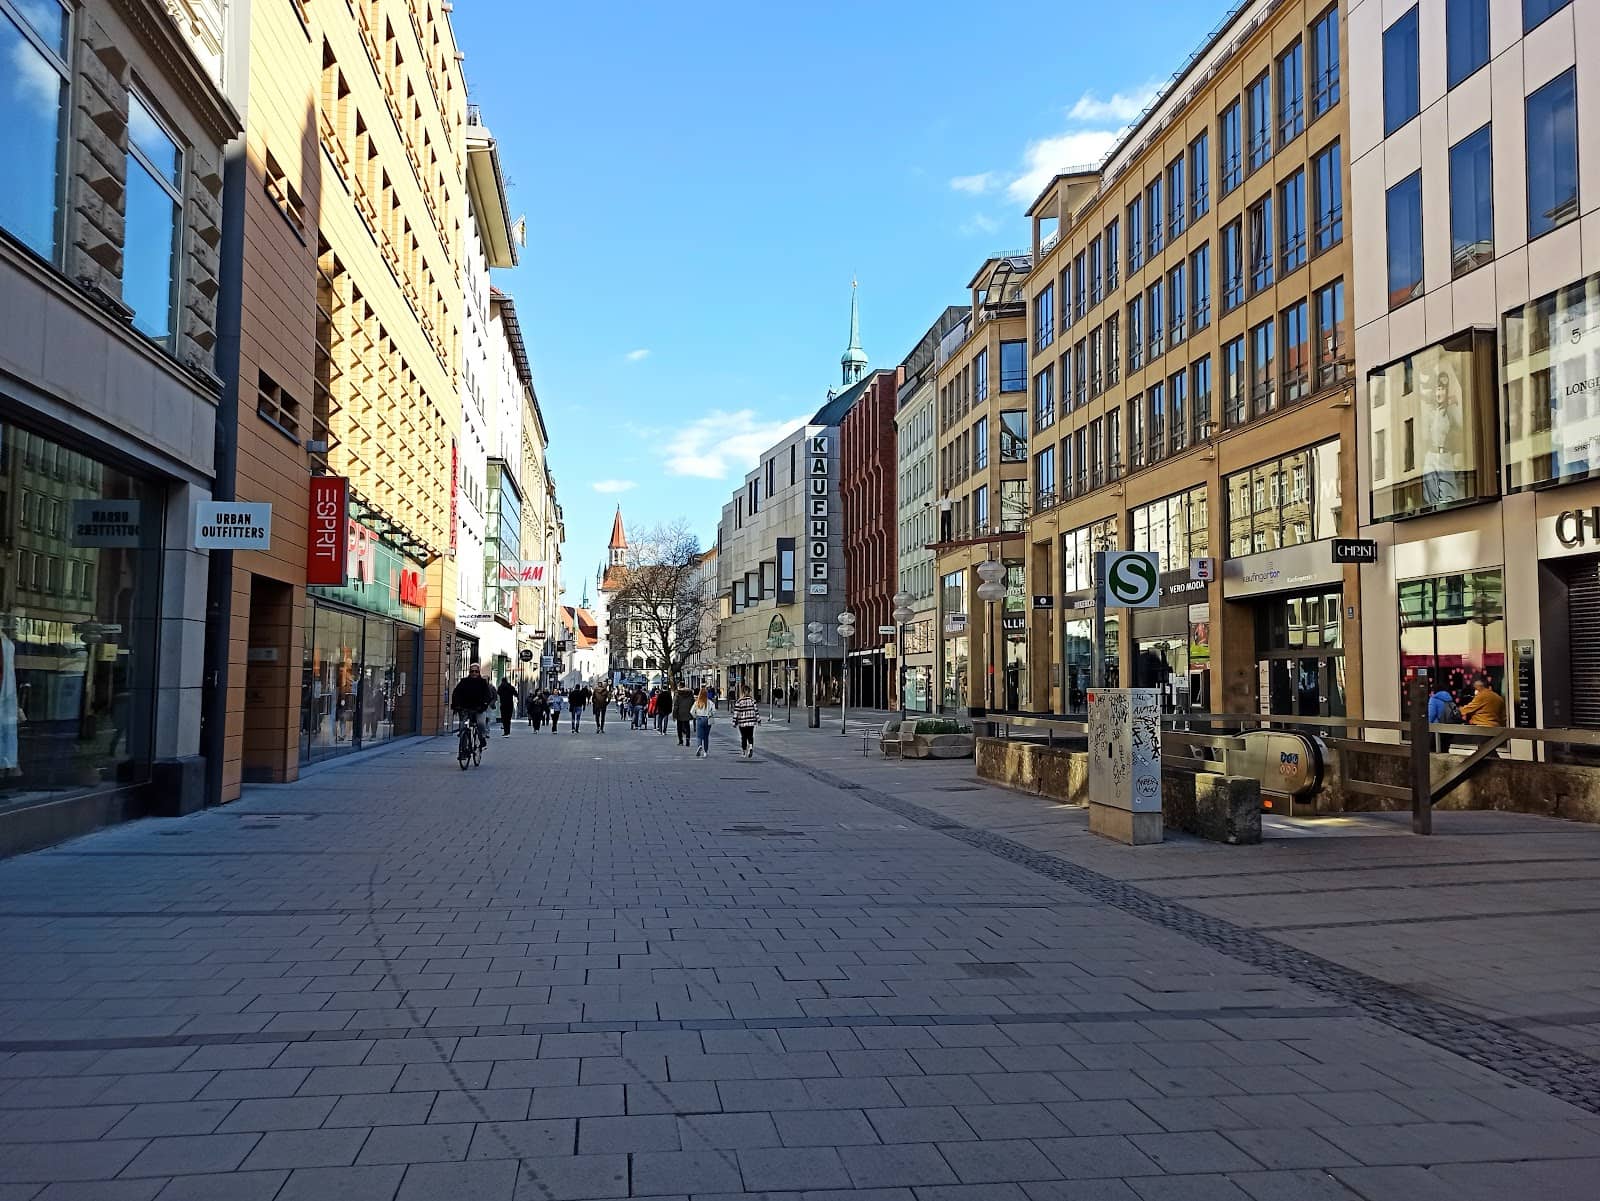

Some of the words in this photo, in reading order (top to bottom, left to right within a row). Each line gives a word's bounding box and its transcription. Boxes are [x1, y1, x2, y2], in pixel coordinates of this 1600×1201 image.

[812, 437, 826, 578] KAUFHOF
[216, 512, 251, 525] URBAN
[316, 488, 337, 562] ESPRIT
[202, 525, 264, 538] OUTFITTERS
[1337, 545, 1372, 557] CHRIST
[520, 566, 543, 580] H&M
[1117, 558, 1149, 601] S
[1169, 584, 1185, 594] VERO
[1185, 580, 1205, 591] MODA
